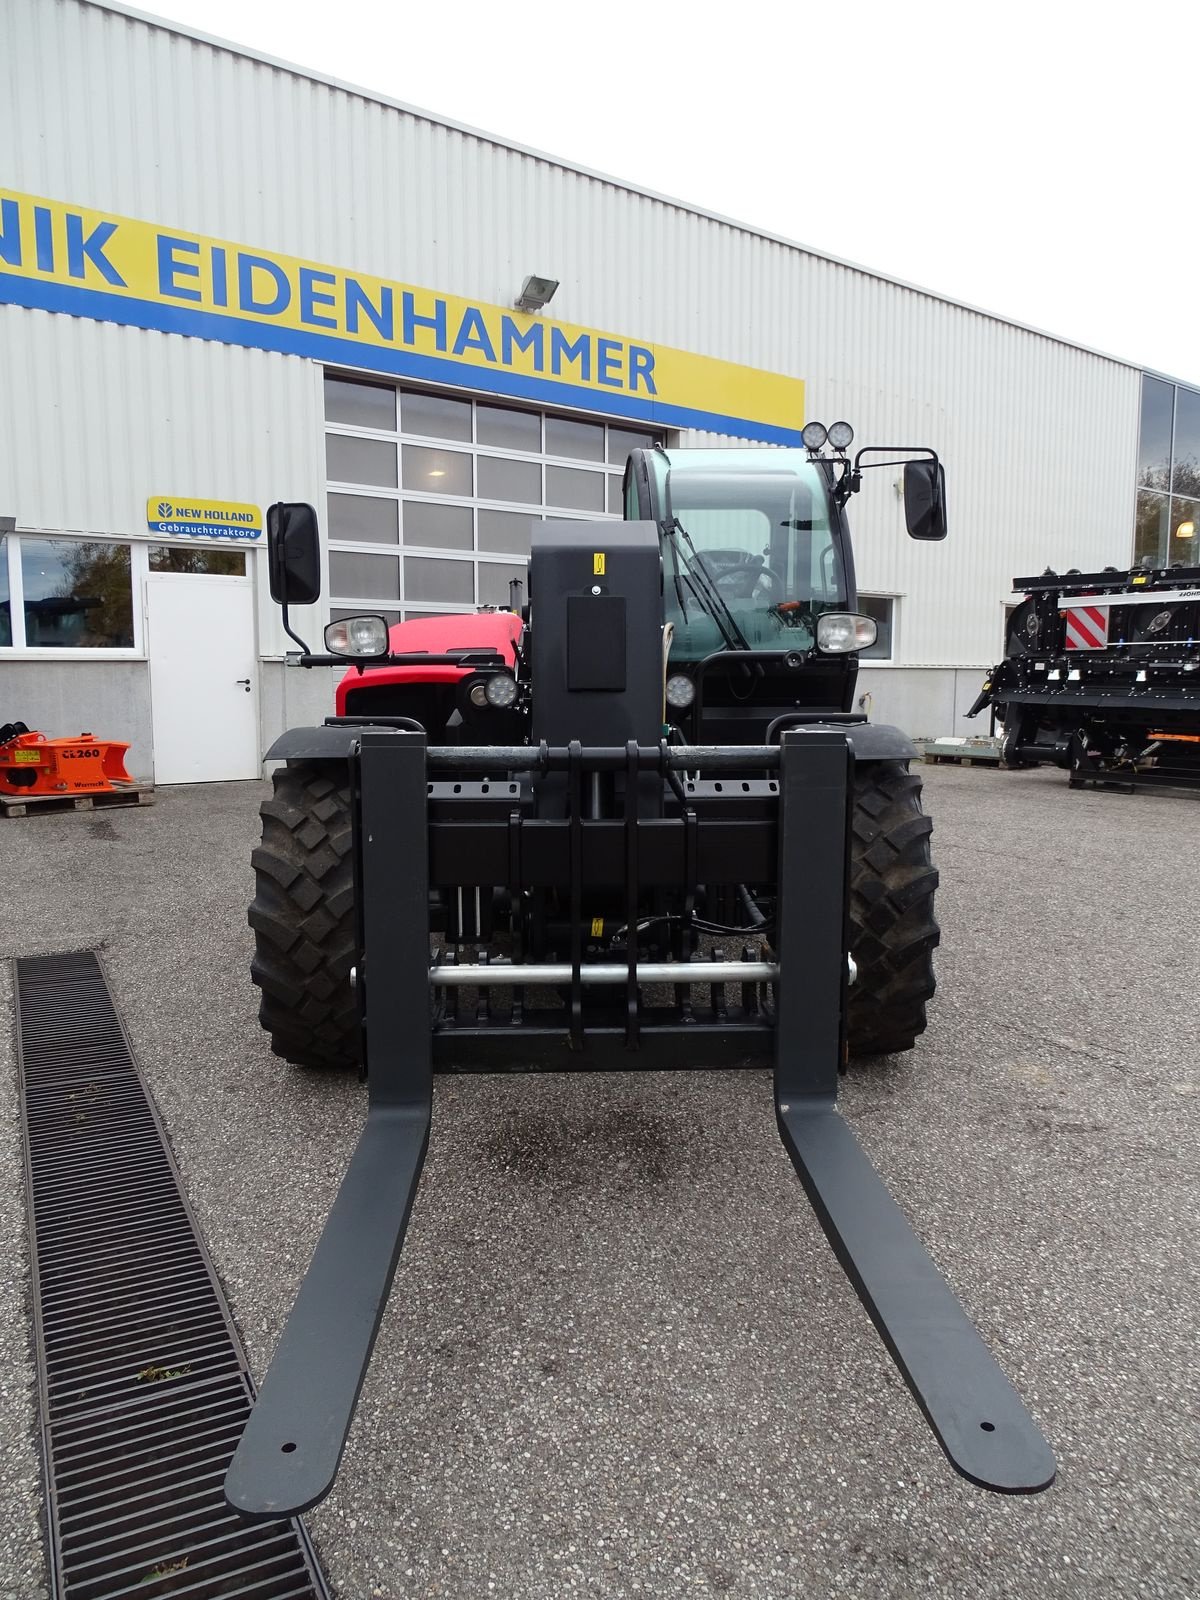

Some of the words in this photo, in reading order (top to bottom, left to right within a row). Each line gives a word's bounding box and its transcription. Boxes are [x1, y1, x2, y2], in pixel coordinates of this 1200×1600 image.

[157, 234, 657, 395] EIDENHAMMER
[176, 508, 201, 518] NEW
[204, 510, 254, 522] HOLLAND
[158, 523, 256, 537] Gebrauchttraktore
